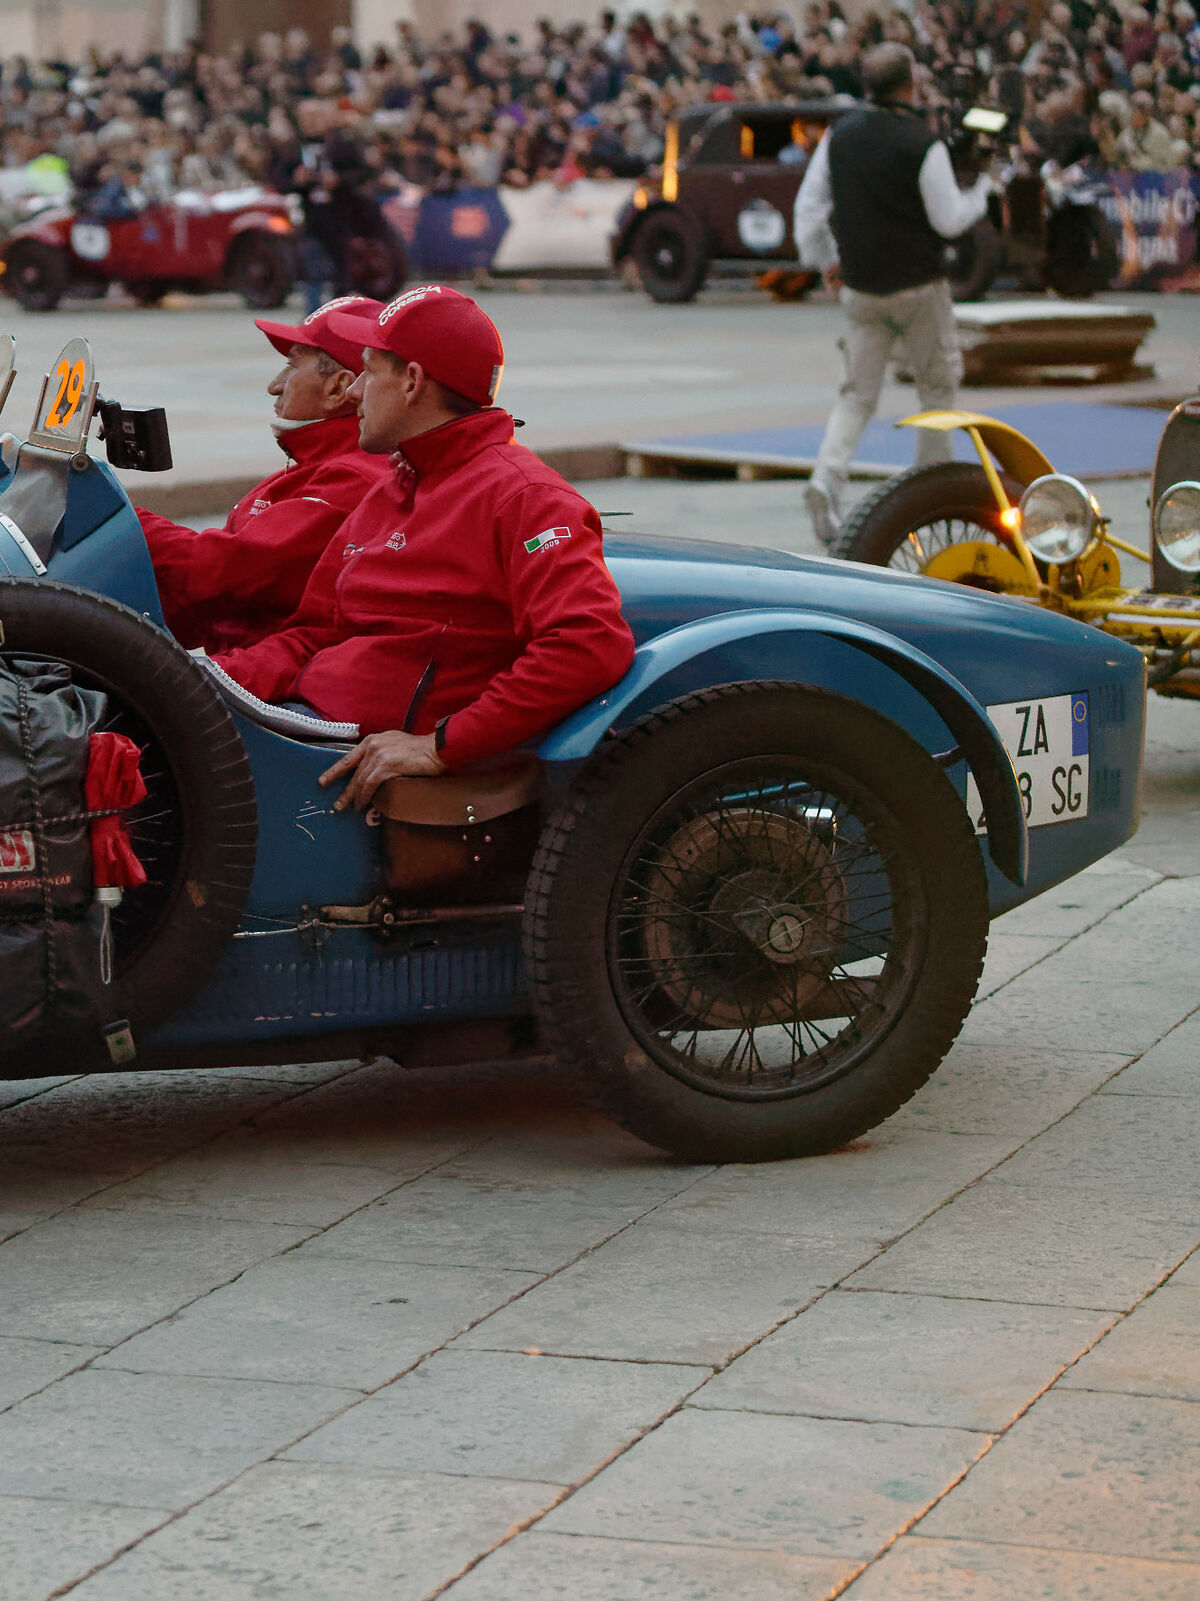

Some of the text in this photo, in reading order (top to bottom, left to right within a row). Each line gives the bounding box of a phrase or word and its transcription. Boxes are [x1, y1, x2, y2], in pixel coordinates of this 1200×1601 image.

[379, 292, 427, 326] CORSE
[45, 359, 85, 429] 29
[1016, 704, 1049, 757] ZA
[1051, 763, 1082, 815] SG
